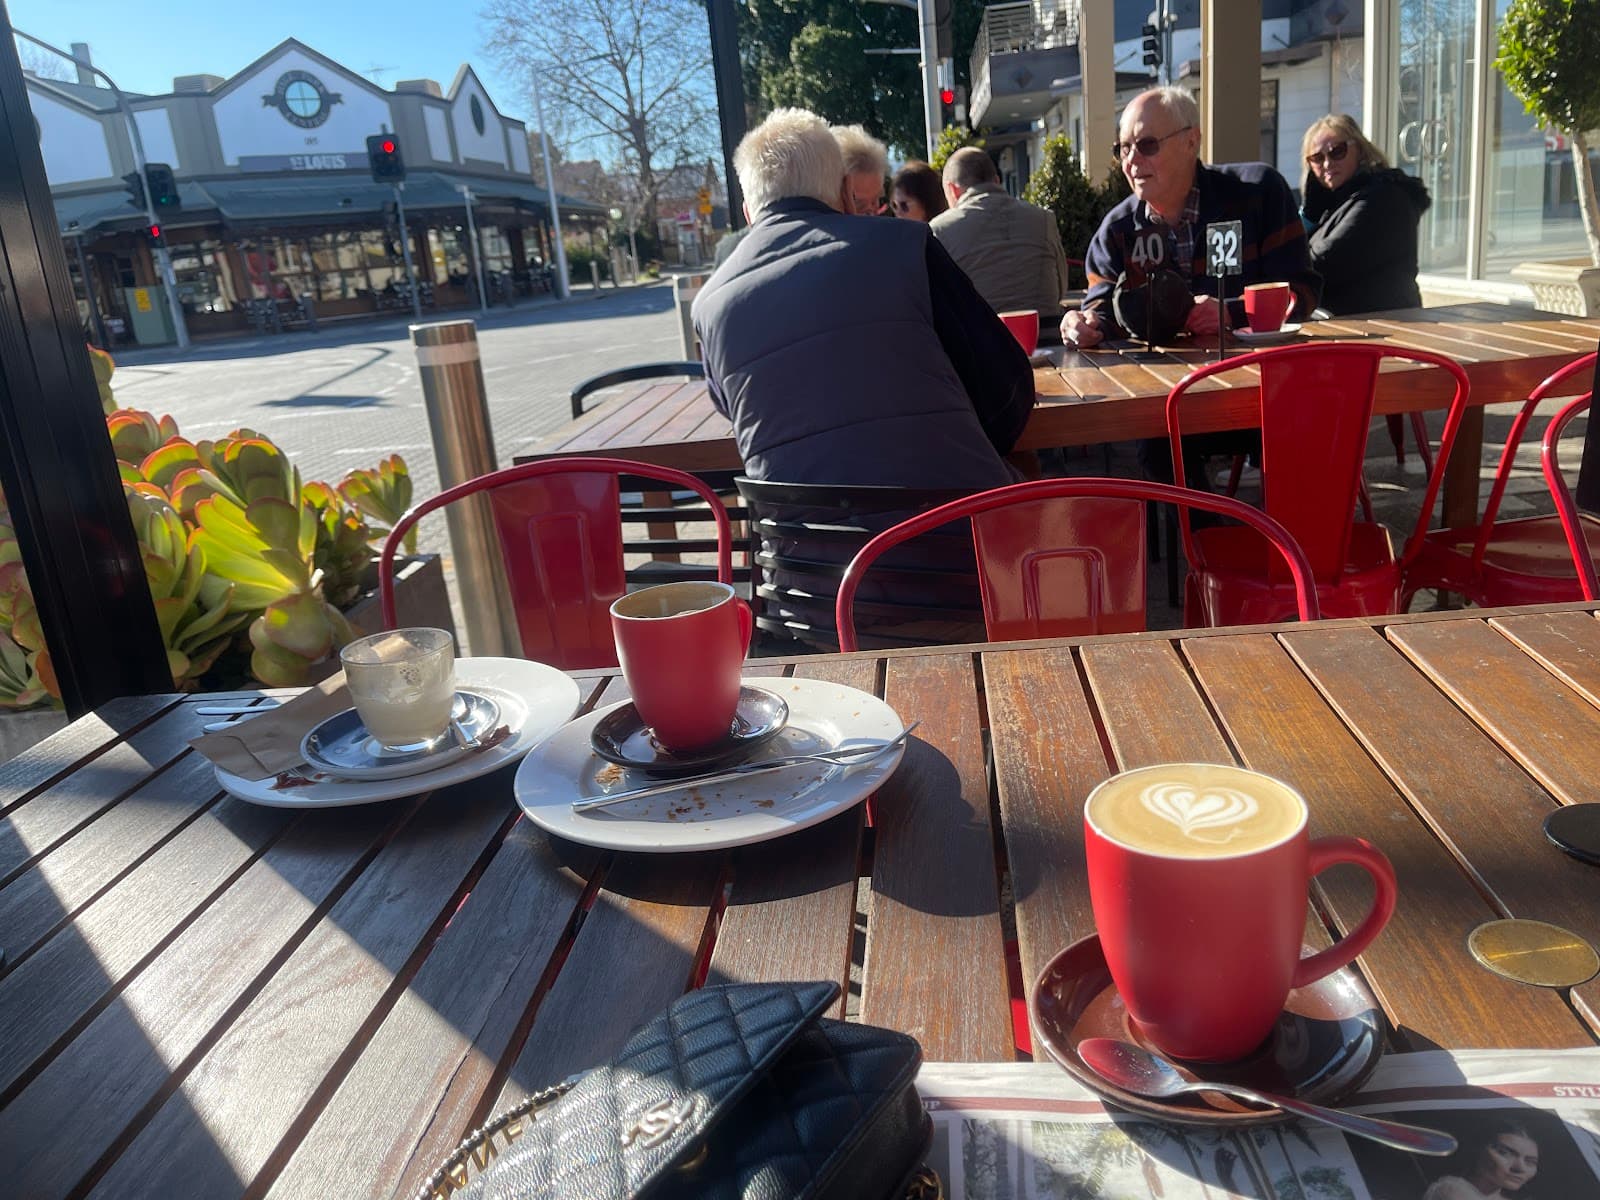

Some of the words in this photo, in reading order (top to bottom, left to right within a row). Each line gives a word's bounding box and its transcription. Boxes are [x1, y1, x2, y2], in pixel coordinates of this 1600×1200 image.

[1131, 233, 1164, 267] 40
[1211, 230, 1237, 266] 32
[1553, 1086, 1600, 1097] STYL
